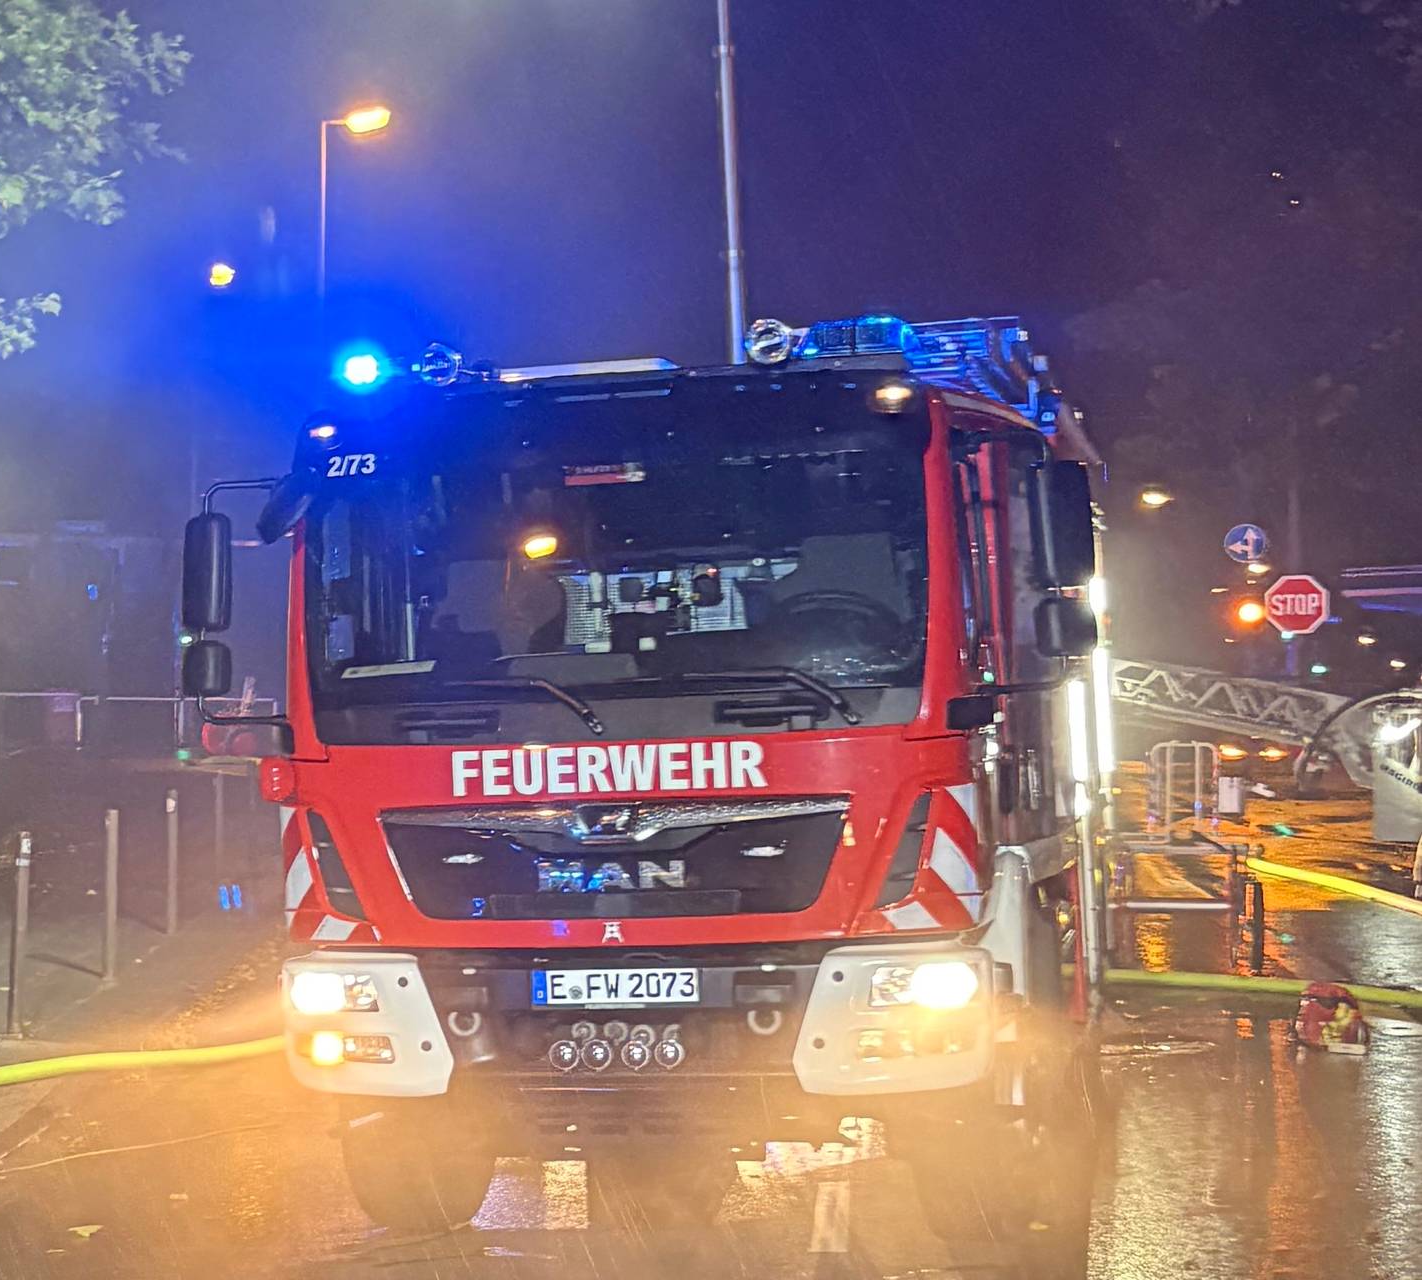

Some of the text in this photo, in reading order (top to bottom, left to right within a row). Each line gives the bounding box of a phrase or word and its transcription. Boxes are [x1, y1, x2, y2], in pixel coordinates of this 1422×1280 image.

[326, 453, 376, 477] 2/73
[1269, 593, 1320, 616] STOP
[452, 741, 769, 797] FEUERWEHR
[537, 859, 685, 893] MAN
[550, 972, 695, 999] E FW 2073
